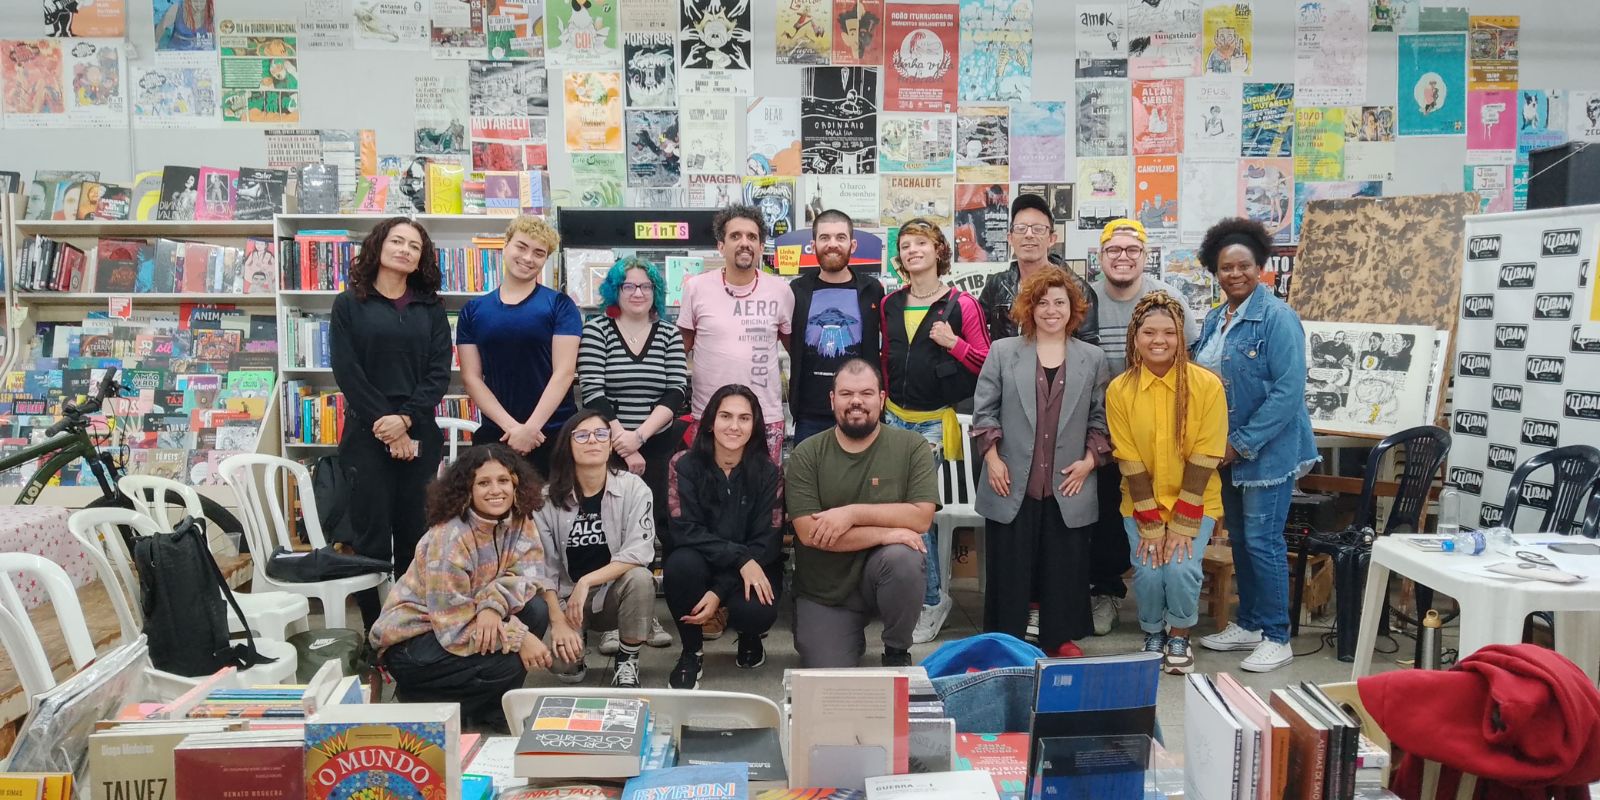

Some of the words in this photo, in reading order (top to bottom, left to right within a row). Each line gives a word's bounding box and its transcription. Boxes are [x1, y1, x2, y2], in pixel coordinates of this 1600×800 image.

[1142, 88, 1173, 96] ALLAN
[472, 118, 526, 130] MUTARELLI
[689, 175, 741, 184] LAVAGEM
[892, 177, 942, 188] CACHALOTE
[733, 300, 778, 316] AERO
[751, 346, 769, 388] 1987
[567, 533, 608, 548] ESCOL
[535, 733, 604, 743] ESCRITOR
[606, 736, 633, 744] DO
[541, 740, 615, 749] JORNADA
[319, 768, 337, 787] O
[336, 750, 430, 782] MUNDO
[102, 778, 168, 800] TALVEZ
[633, 783, 736, 800] BYRON
